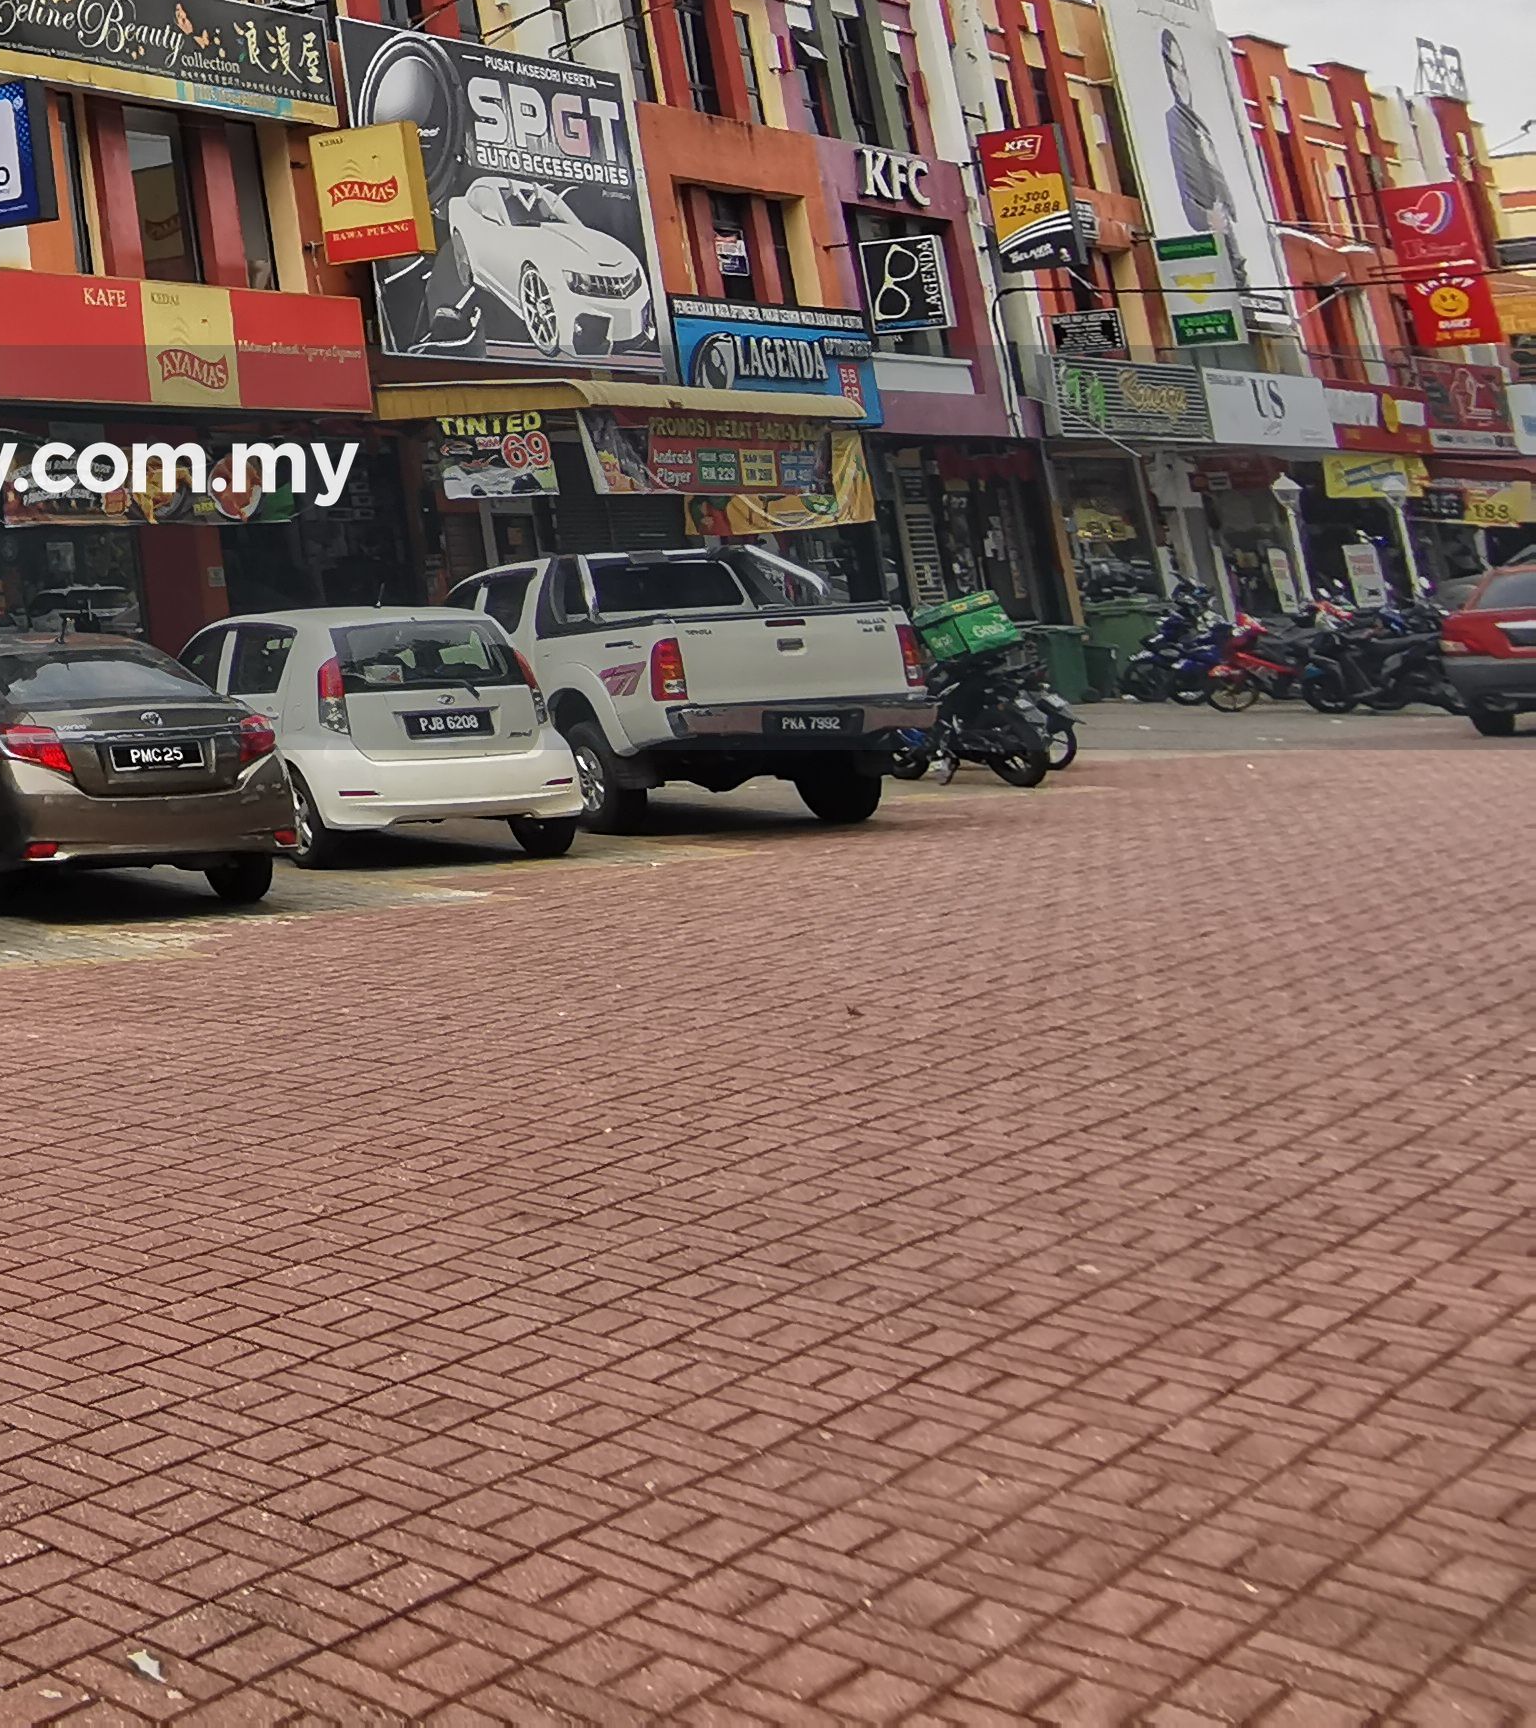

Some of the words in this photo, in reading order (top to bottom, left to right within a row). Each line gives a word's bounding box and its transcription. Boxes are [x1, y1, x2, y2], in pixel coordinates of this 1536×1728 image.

[182, 52, 241, 74] collection
[485, 55, 514, 74] PUSAT
[515, 62, 561, 83] AKSESORI
[468, 77, 620, 162] SPGT
[1005, 139, 1035, 152] KFC
[860, 148, 931, 206] KFC
[333, 183, 395, 201] AYAMAS
[367, 222, 408, 236] PULANG
[917, 240, 944, 319] LAGENDA
[83, 287, 127, 308] KAFE
[735, 334, 828, 379] LAGENDA
[161, 351, 227, 388] AYAMAS
[1249, 378, 1286, 419] US
[437, 412, 541, 435] TINTED
[501, 431, 551, 470] 69
[657, 468, 692, 486] Player
[420, 717, 444, 732] PJB
[446, 715, 479, 730] 6208
[782, 718, 805, 730] PKA
